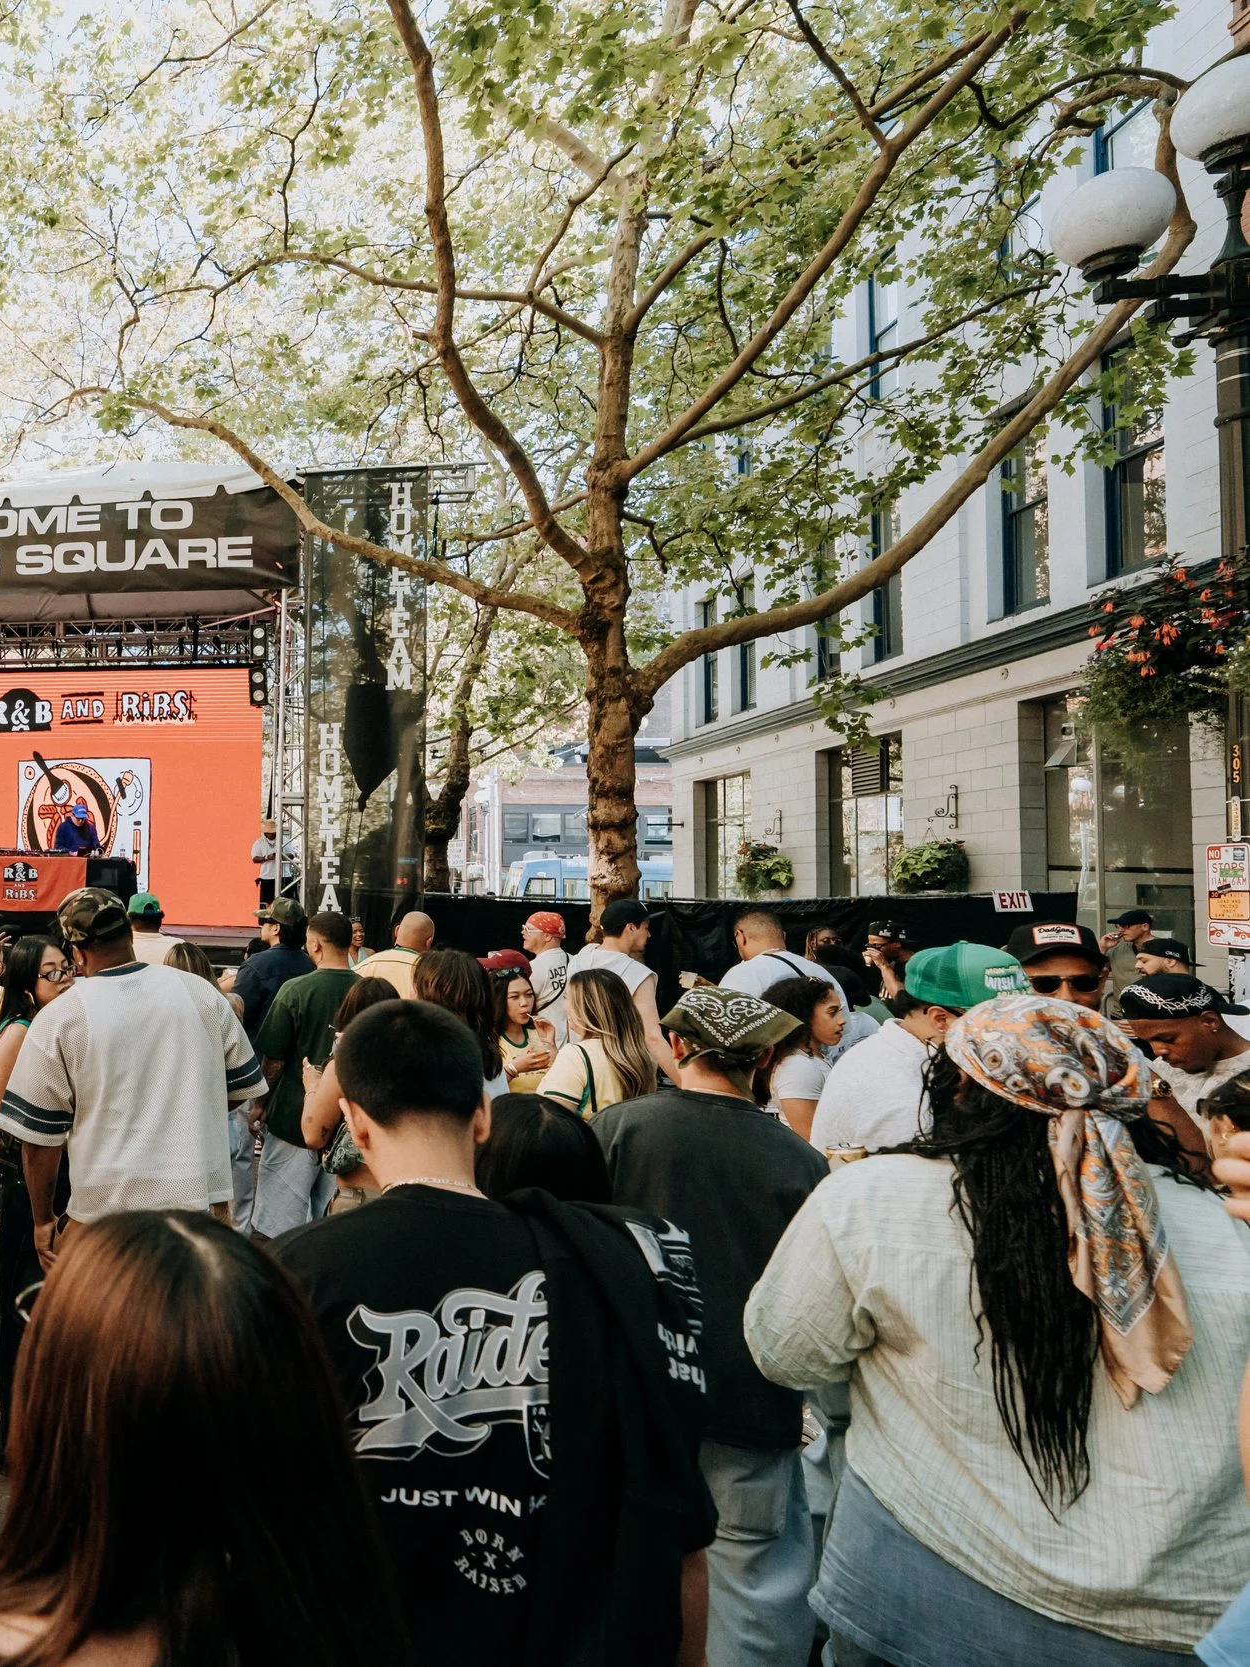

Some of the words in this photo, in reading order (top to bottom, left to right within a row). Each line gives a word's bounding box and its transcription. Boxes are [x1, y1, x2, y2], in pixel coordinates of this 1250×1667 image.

[116, 500, 193, 530] TO
[15, 536, 253, 574] SQUARE
[385, 482, 413, 690] HOMETEAM
[61, 698, 105, 719] AND
[1232, 744, 1240, 783] 305
[316, 723, 344, 913] HOMETEA
[1208, 850, 1220, 859] NO
[4, 864, 38, 880] R&B
[998, 893, 1027, 908] EXIT
[1038, 926, 1075, 935] DadGang
[347, 1270, 548, 1454] Raide
[380, 1487, 459, 1507] JUST
[465, 1486, 521, 1517] WIN
[459, 1528, 525, 1562] BORN
[454, 1555, 527, 1594] RAISED
